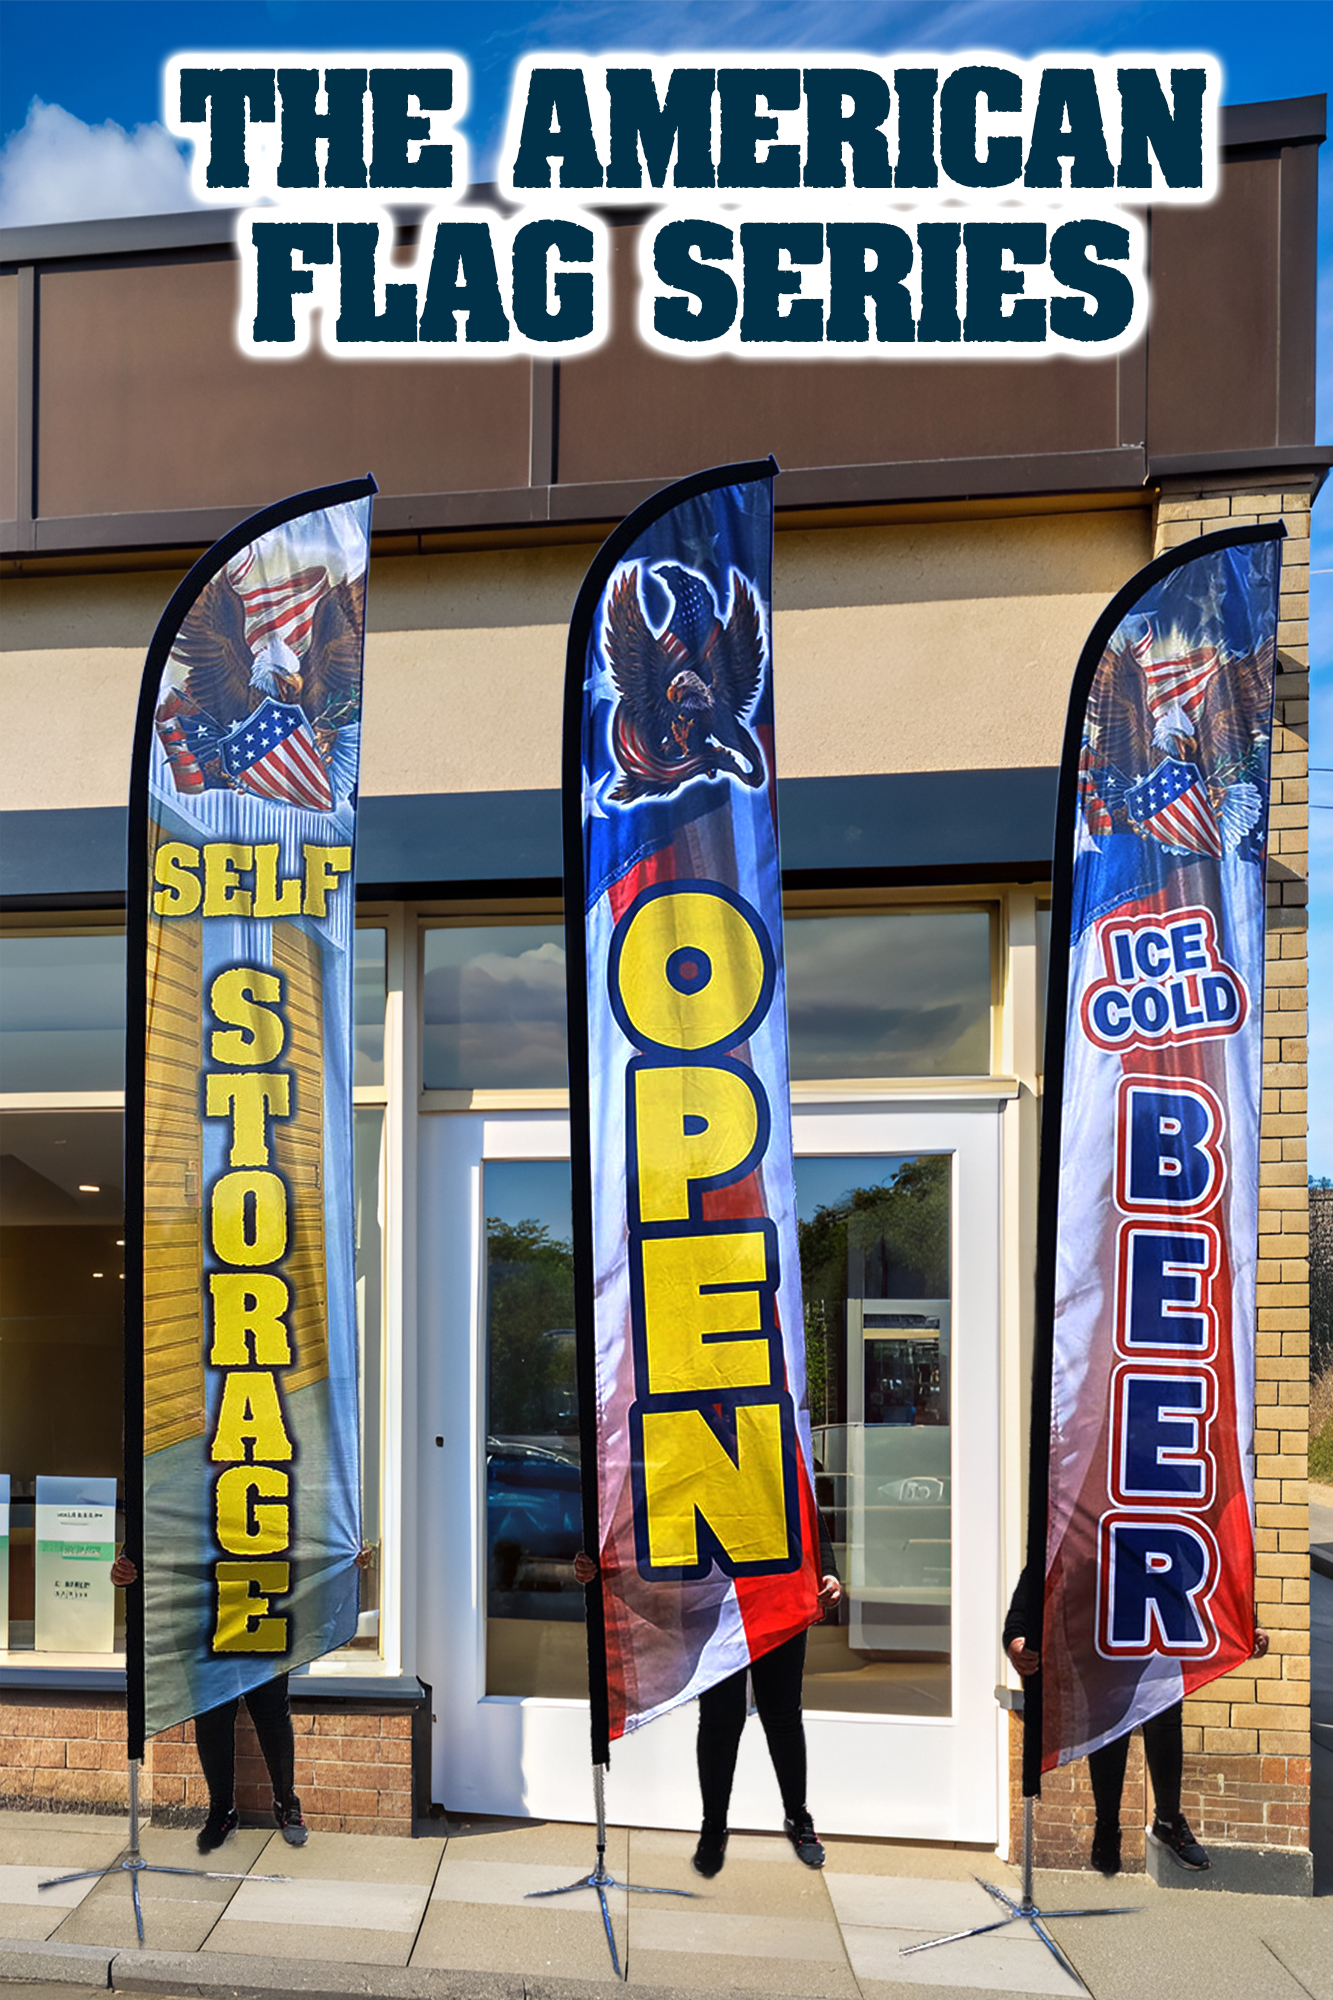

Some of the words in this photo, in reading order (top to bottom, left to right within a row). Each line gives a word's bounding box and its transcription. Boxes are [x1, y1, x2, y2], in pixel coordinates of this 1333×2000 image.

[153, 842, 352, 918] SELF
[1088, 974, 1238, 1038] COLD
[1111, 921, 1208, 980] ICE
[205, 966, 293, 1654] STORAGE
[617, 892, 790, 1568] OPEN
[1112, 1090, 1211, 1644] BEER
